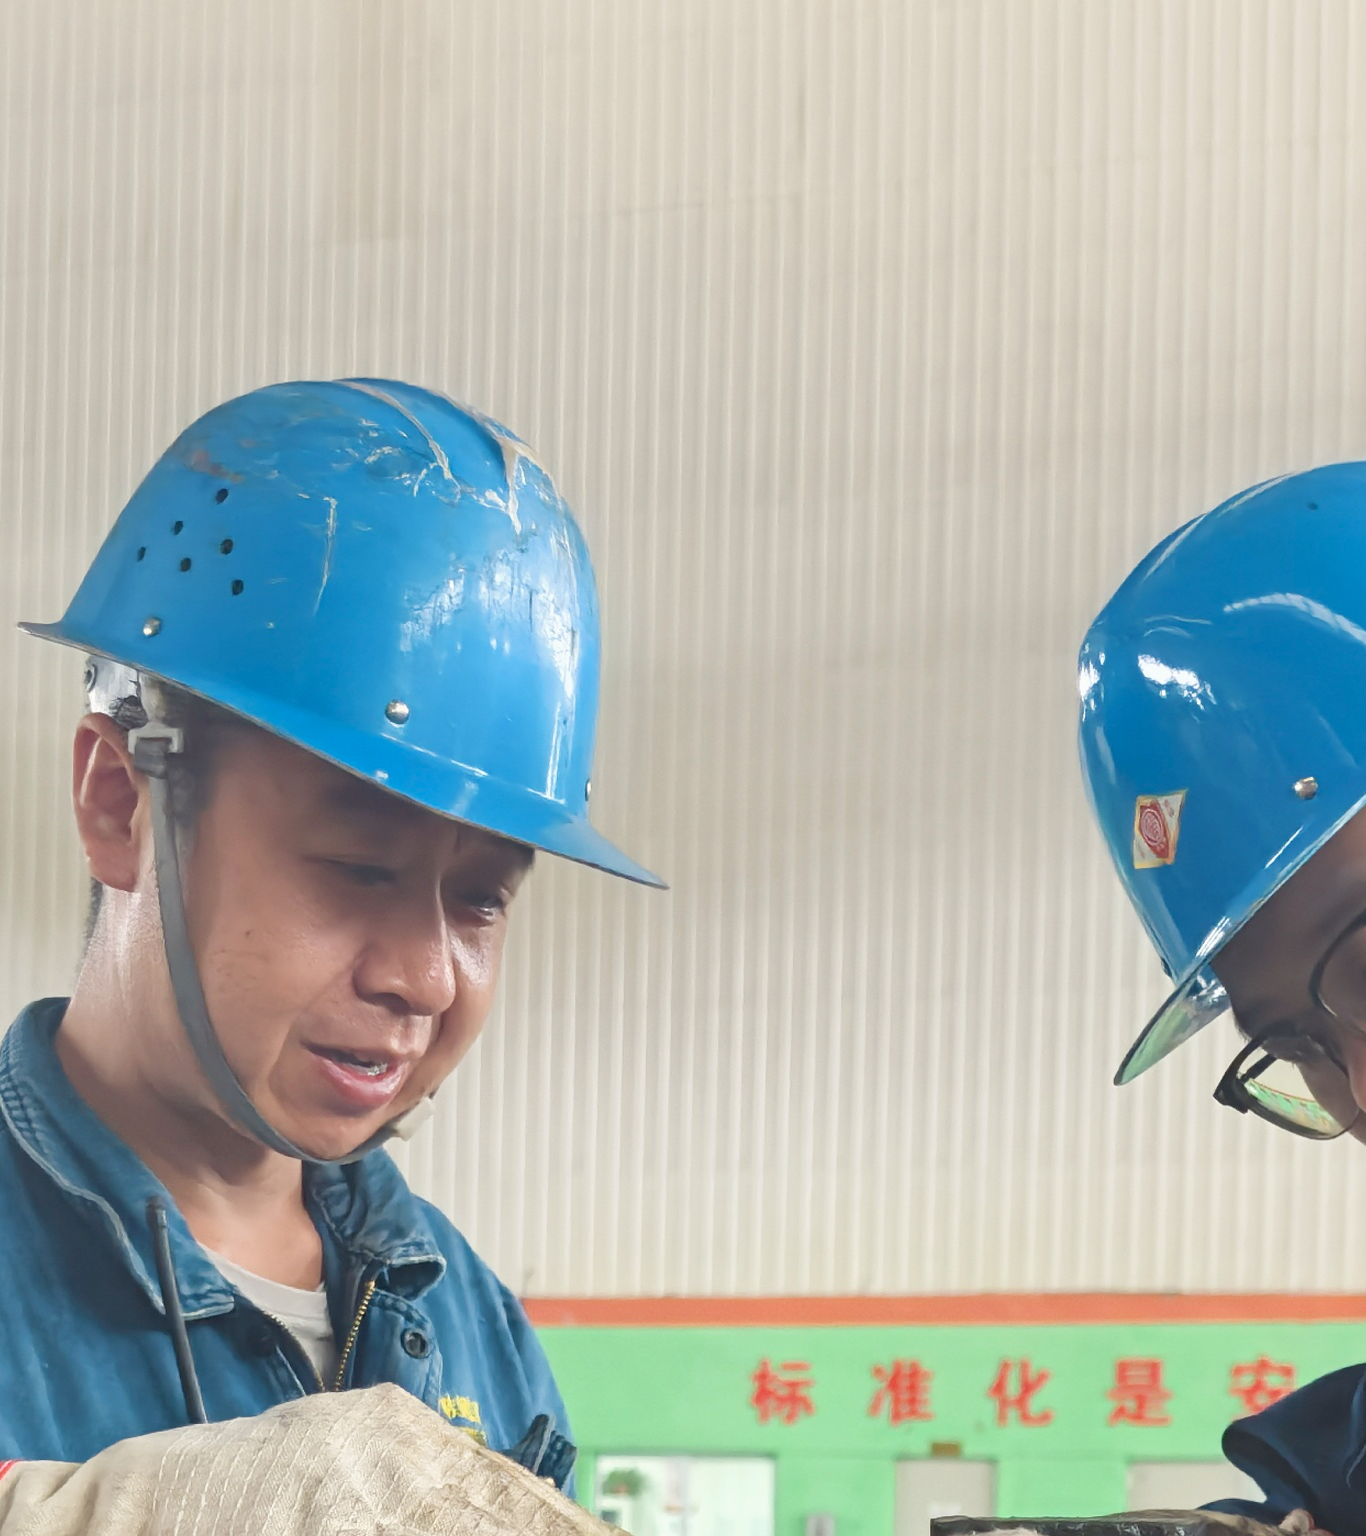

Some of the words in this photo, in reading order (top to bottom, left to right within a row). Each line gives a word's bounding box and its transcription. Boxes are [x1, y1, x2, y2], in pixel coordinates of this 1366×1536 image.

[749, 1356, 1296, 1427] 标准化是安
